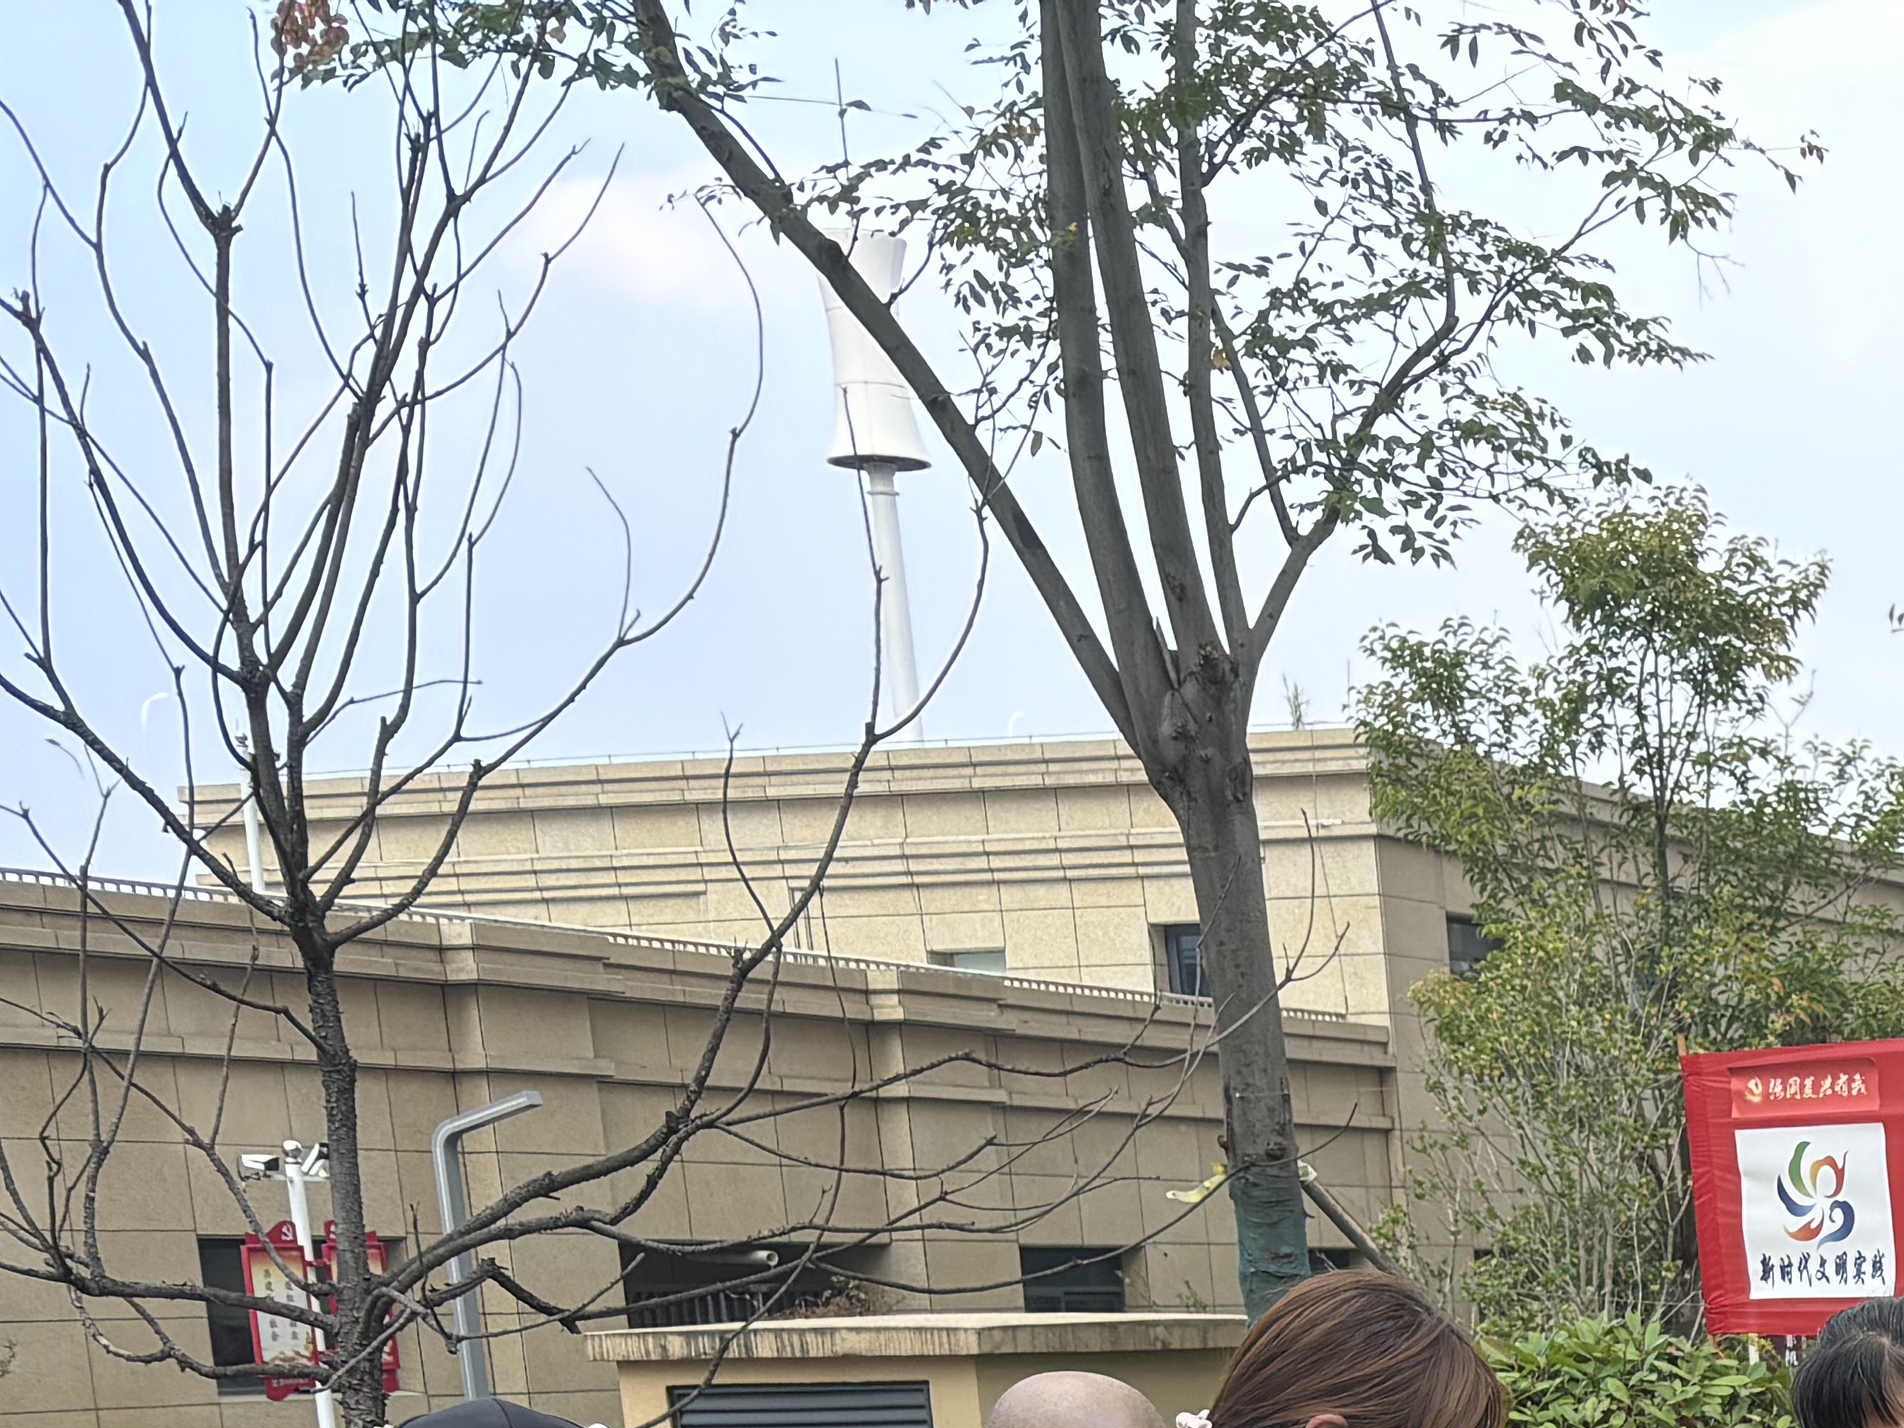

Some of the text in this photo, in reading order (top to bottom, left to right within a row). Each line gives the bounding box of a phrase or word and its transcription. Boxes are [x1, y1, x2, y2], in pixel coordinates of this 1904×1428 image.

[1759, 1248, 1887, 1289] 新时代文明实践
